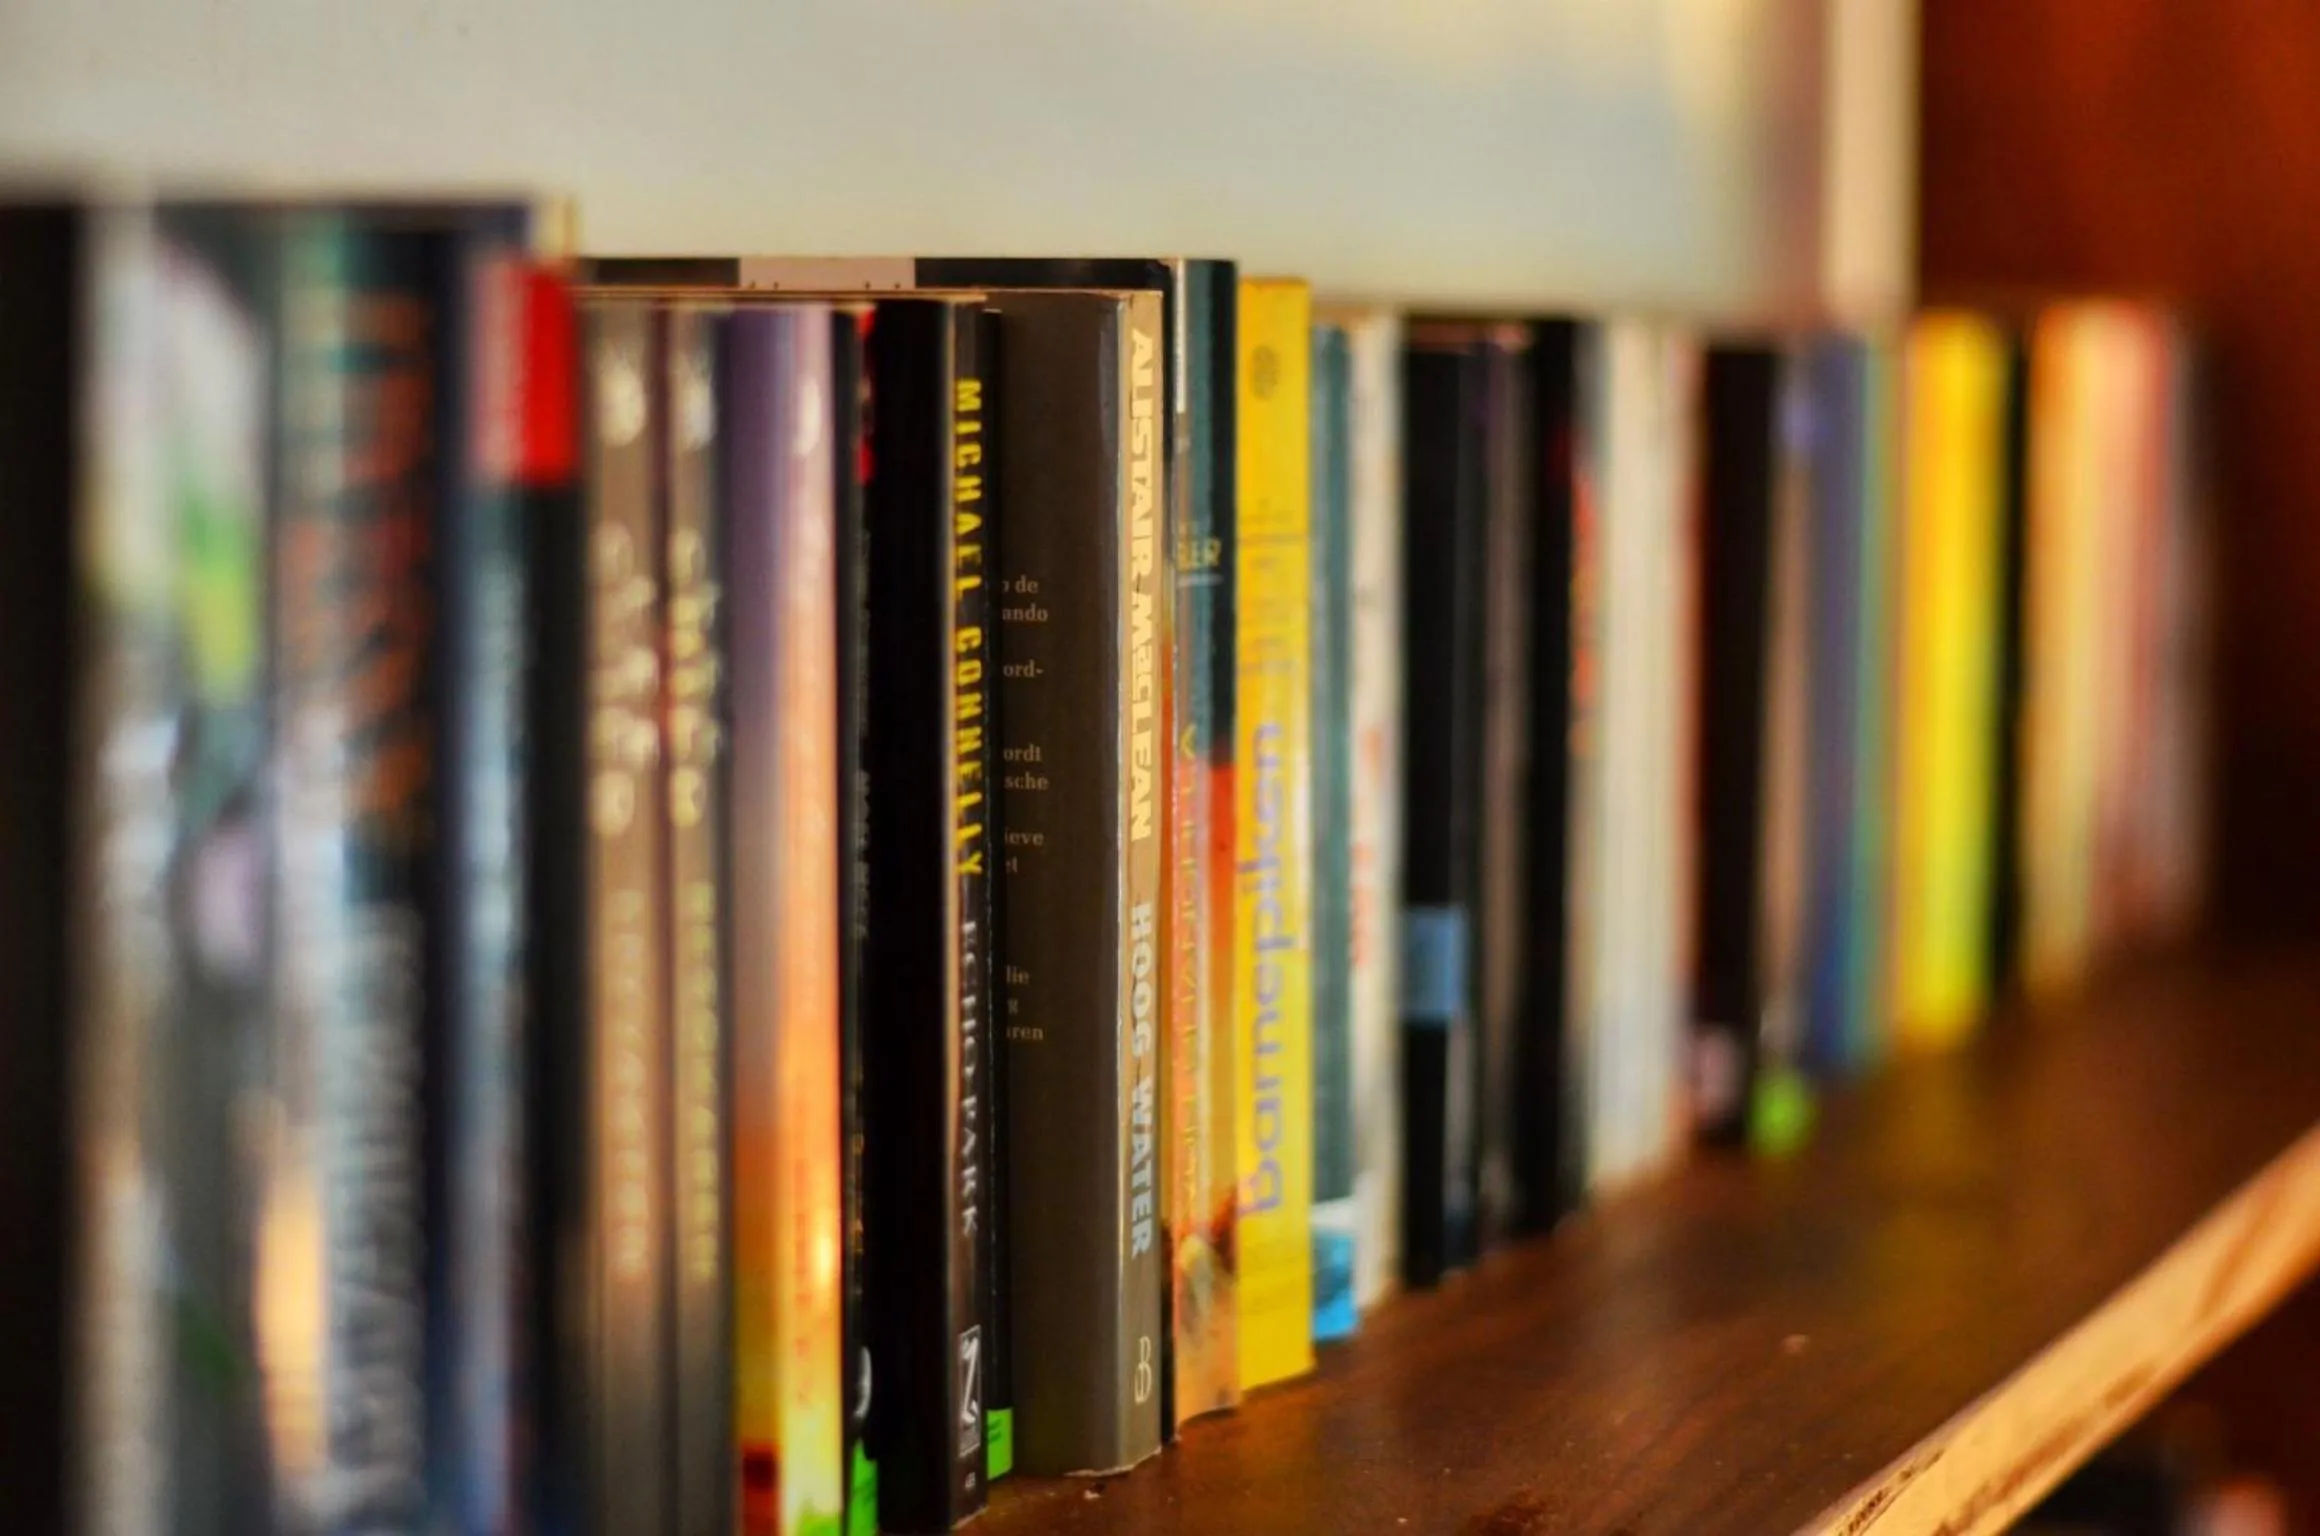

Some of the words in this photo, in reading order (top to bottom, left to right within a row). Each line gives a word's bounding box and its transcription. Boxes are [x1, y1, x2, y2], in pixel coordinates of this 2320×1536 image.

[955, 379, 983, 602] MICHAEL
[1131, 328, 1153, 579] ALISTAIR
[1014, 574, 1039, 594] de
[1002, 659, 1044, 678] ord-
[955, 627, 983, 876] CONNELLY
[1003, 771, 1049, 791] sche
[1131, 901, 1153, 1057] HOOG
[961, 1095, 978, 1237] PARK
[1131, 1073, 1153, 1259] WATER
